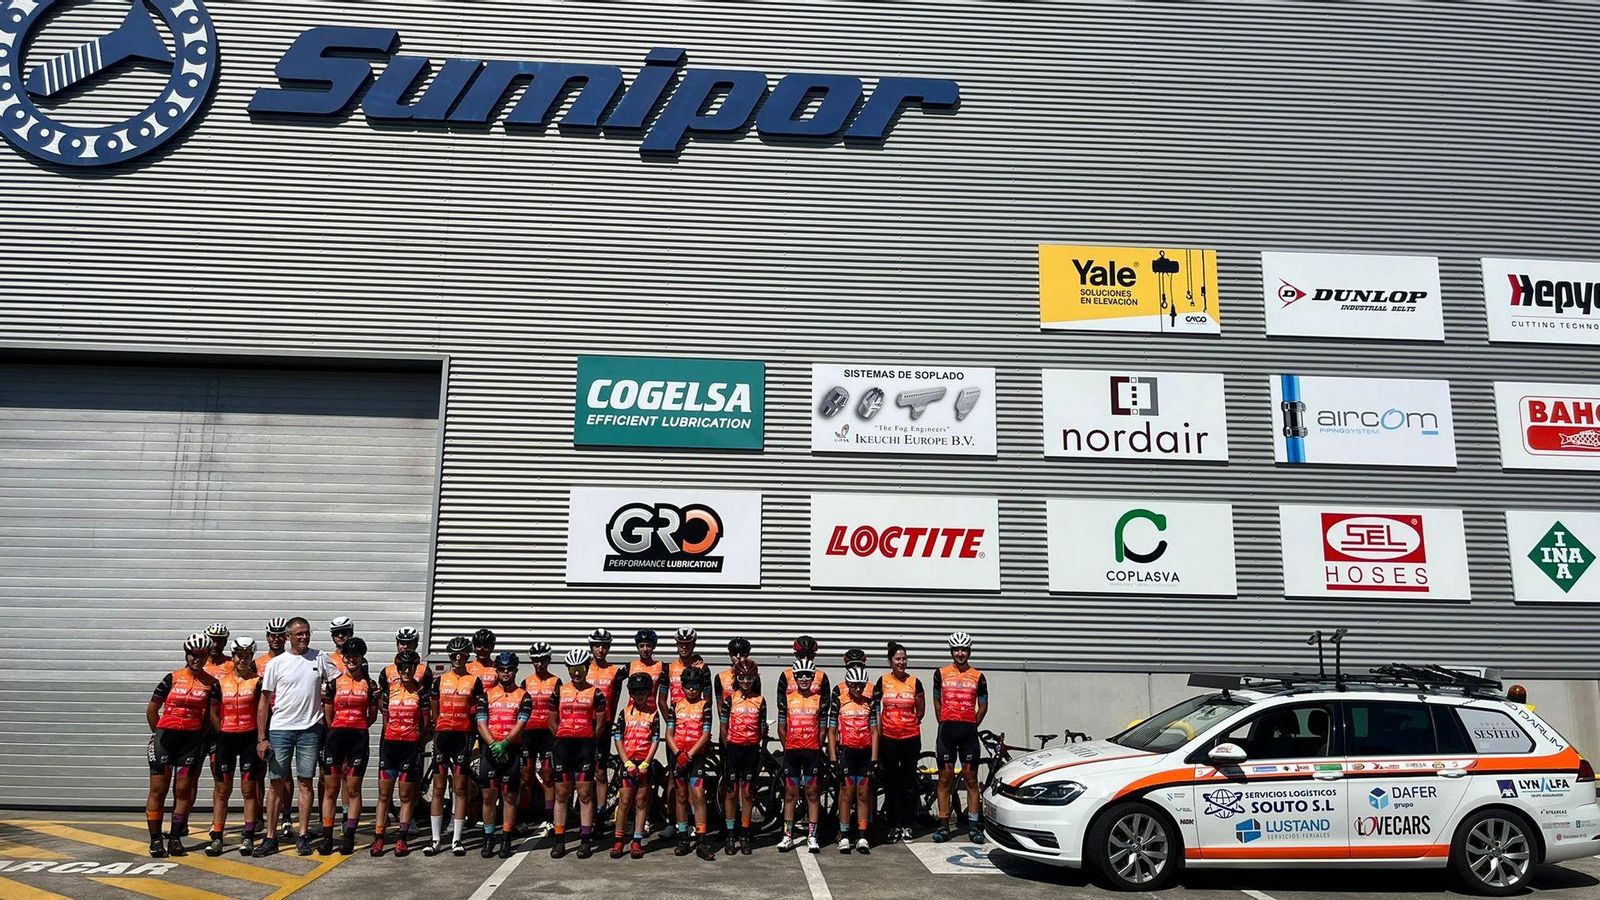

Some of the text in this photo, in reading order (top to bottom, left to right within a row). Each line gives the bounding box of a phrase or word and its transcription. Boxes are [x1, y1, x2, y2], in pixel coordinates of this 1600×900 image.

[248, 26, 960, 158] Sumipor
[1072, 259, 1136, 287] Yale
[1080, 289, 1132, 297] SOLUCIONES
[1312, 288, 1428, 303] DUNLOP
[1507, 274, 1600, 314] Hepy
[1093, 297, 1138, 306] ELEVACIÓN
[1511, 320, 1555, 328] CUTTING
[844, 369, 965, 380] SISTEMAS DE SOPLADO
[586, 379, 752, 413] COGELSA
[1528, 400, 1600, 425] BAH
[586, 414, 752, 429] EFFICIENT LUBRICATION
[894, 425, 908, 433] Fog
[951, 436, 975, 446] B.V.
[1063, 422, 1209, 454] nordair
[609, 506, 720, 554] GRO
[1341, 524, 1407, 546] SEL
[825, 524, 985, 558] LOCTITE
[1540, 547, 1585, 563] INA
[608, 559, 718, 568] PERFORMANCE LUBRICATION
[1106, 570, 1181, 582] COPLASVA
[1325, 566, 1428, 584] HOSES
[1473, 728, 1520, 739] SESTELO
[1245, 788, 1337, 799] SERVICIOS LOGÍSTICOS
[1392, 786, 1437, 798] DAFER
[1251, 799, 1335, 814] SOUTO S.L
[1265, 818, 1330, 833] LUSTAND
[1354, 815, 1431, 837] LOVECARS
